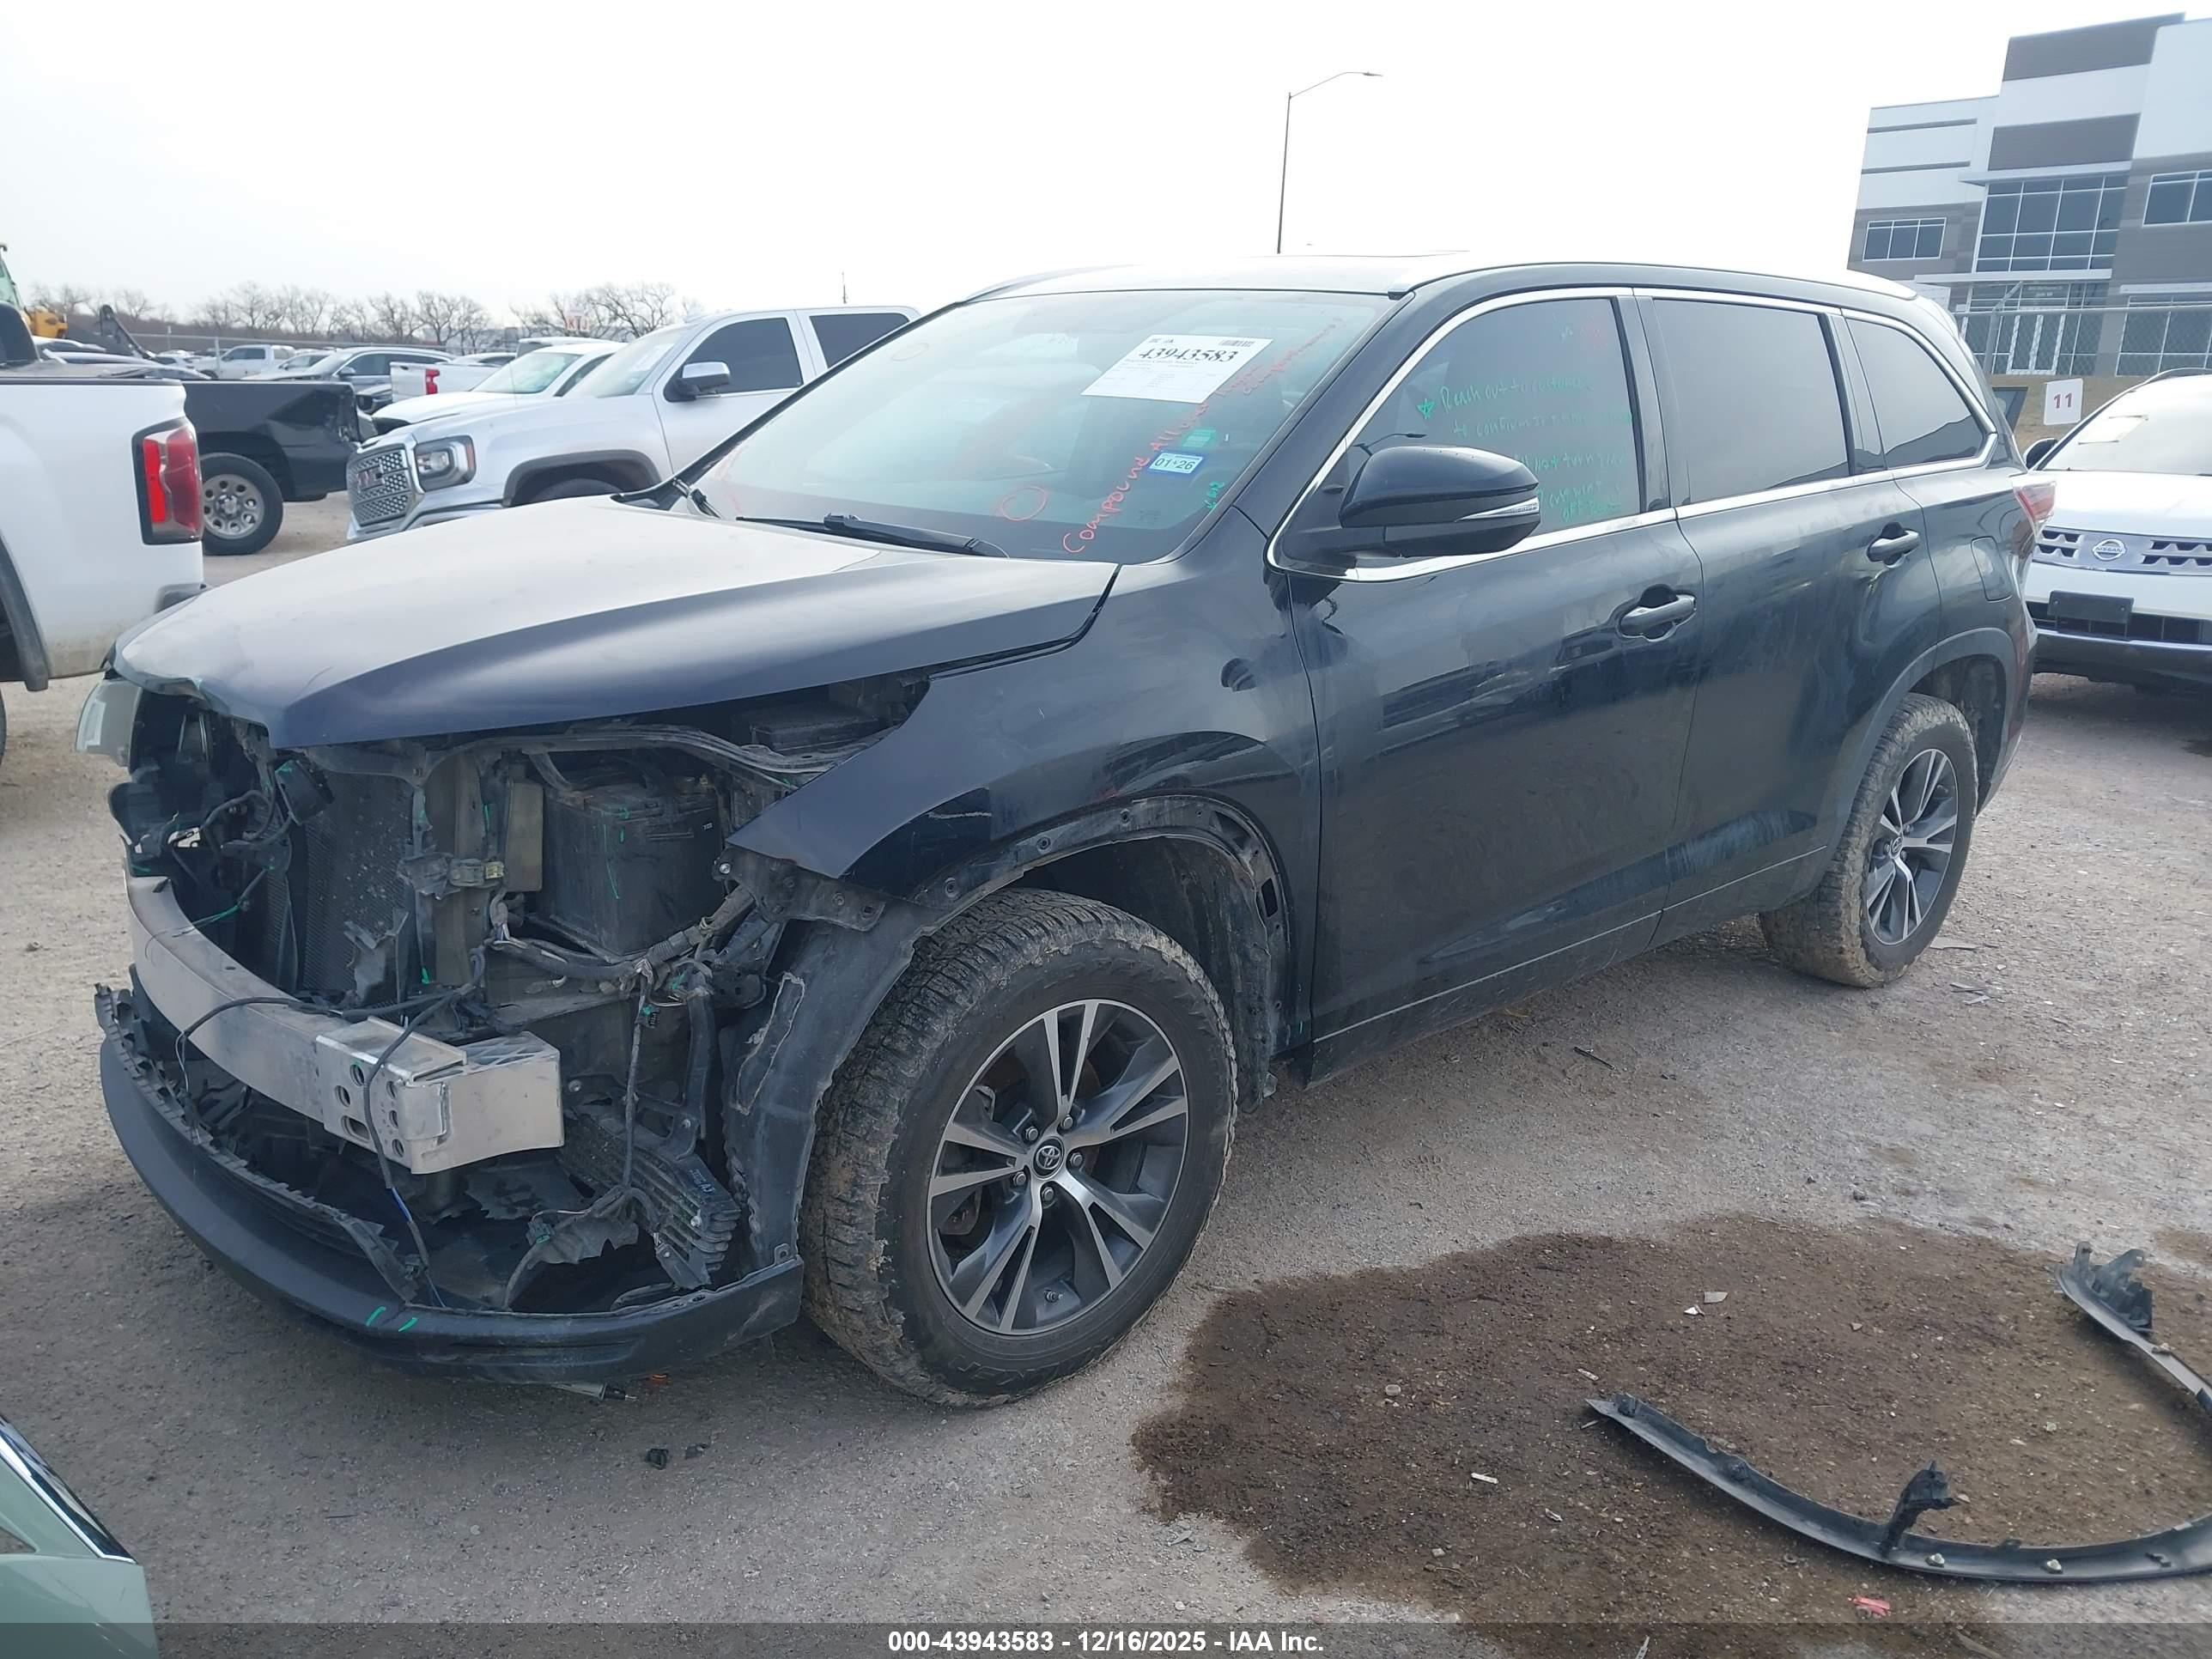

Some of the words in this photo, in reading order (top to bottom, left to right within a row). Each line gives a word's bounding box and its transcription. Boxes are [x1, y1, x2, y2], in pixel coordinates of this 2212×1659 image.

[1139, 348, 1239, 362] 43943583
[1440, 386, 1480, 414] Reach
[1485, 380, 1508, 399] out
[2053, 392, 2073, 409] 11
